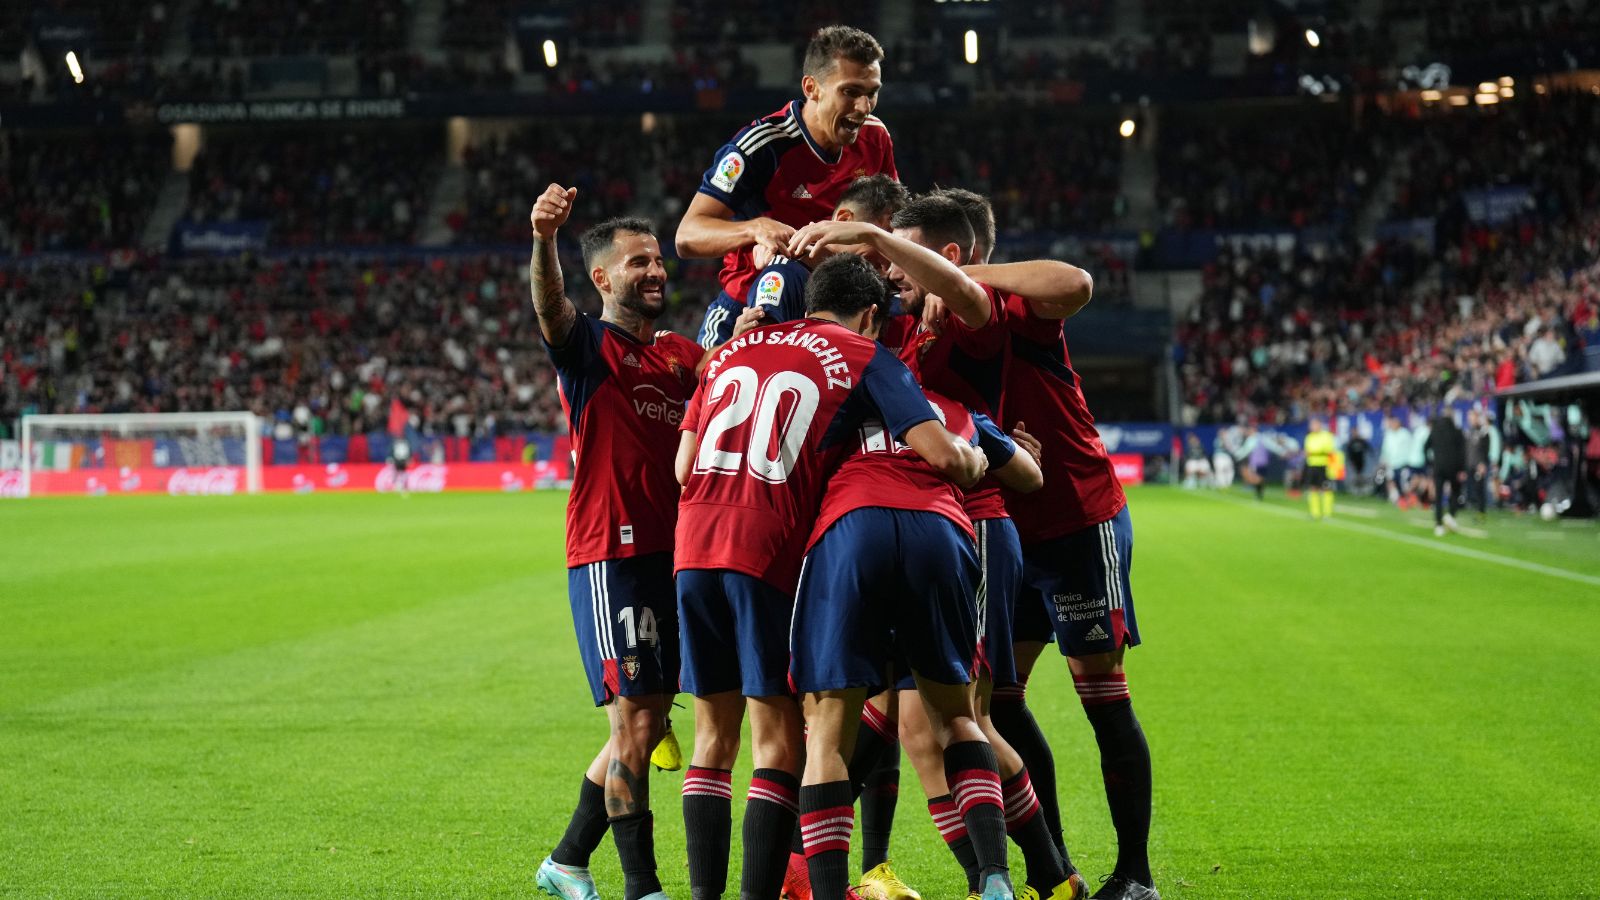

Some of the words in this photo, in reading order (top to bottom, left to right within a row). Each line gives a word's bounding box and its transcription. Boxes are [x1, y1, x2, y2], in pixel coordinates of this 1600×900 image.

[708, 331, 764, 379] MANU
[765, 329, 852, 390] SÁNCHEZ
[693, 366, 820, 484] 20
[1053, 592, 1082, 604] Clínica
[1055, 596, 1107, 613] Universidad
[617, 606, 658, 649] 14
[1057, 612, 1068, 622] de
[1070, 609, 1105, 621] Navarra
